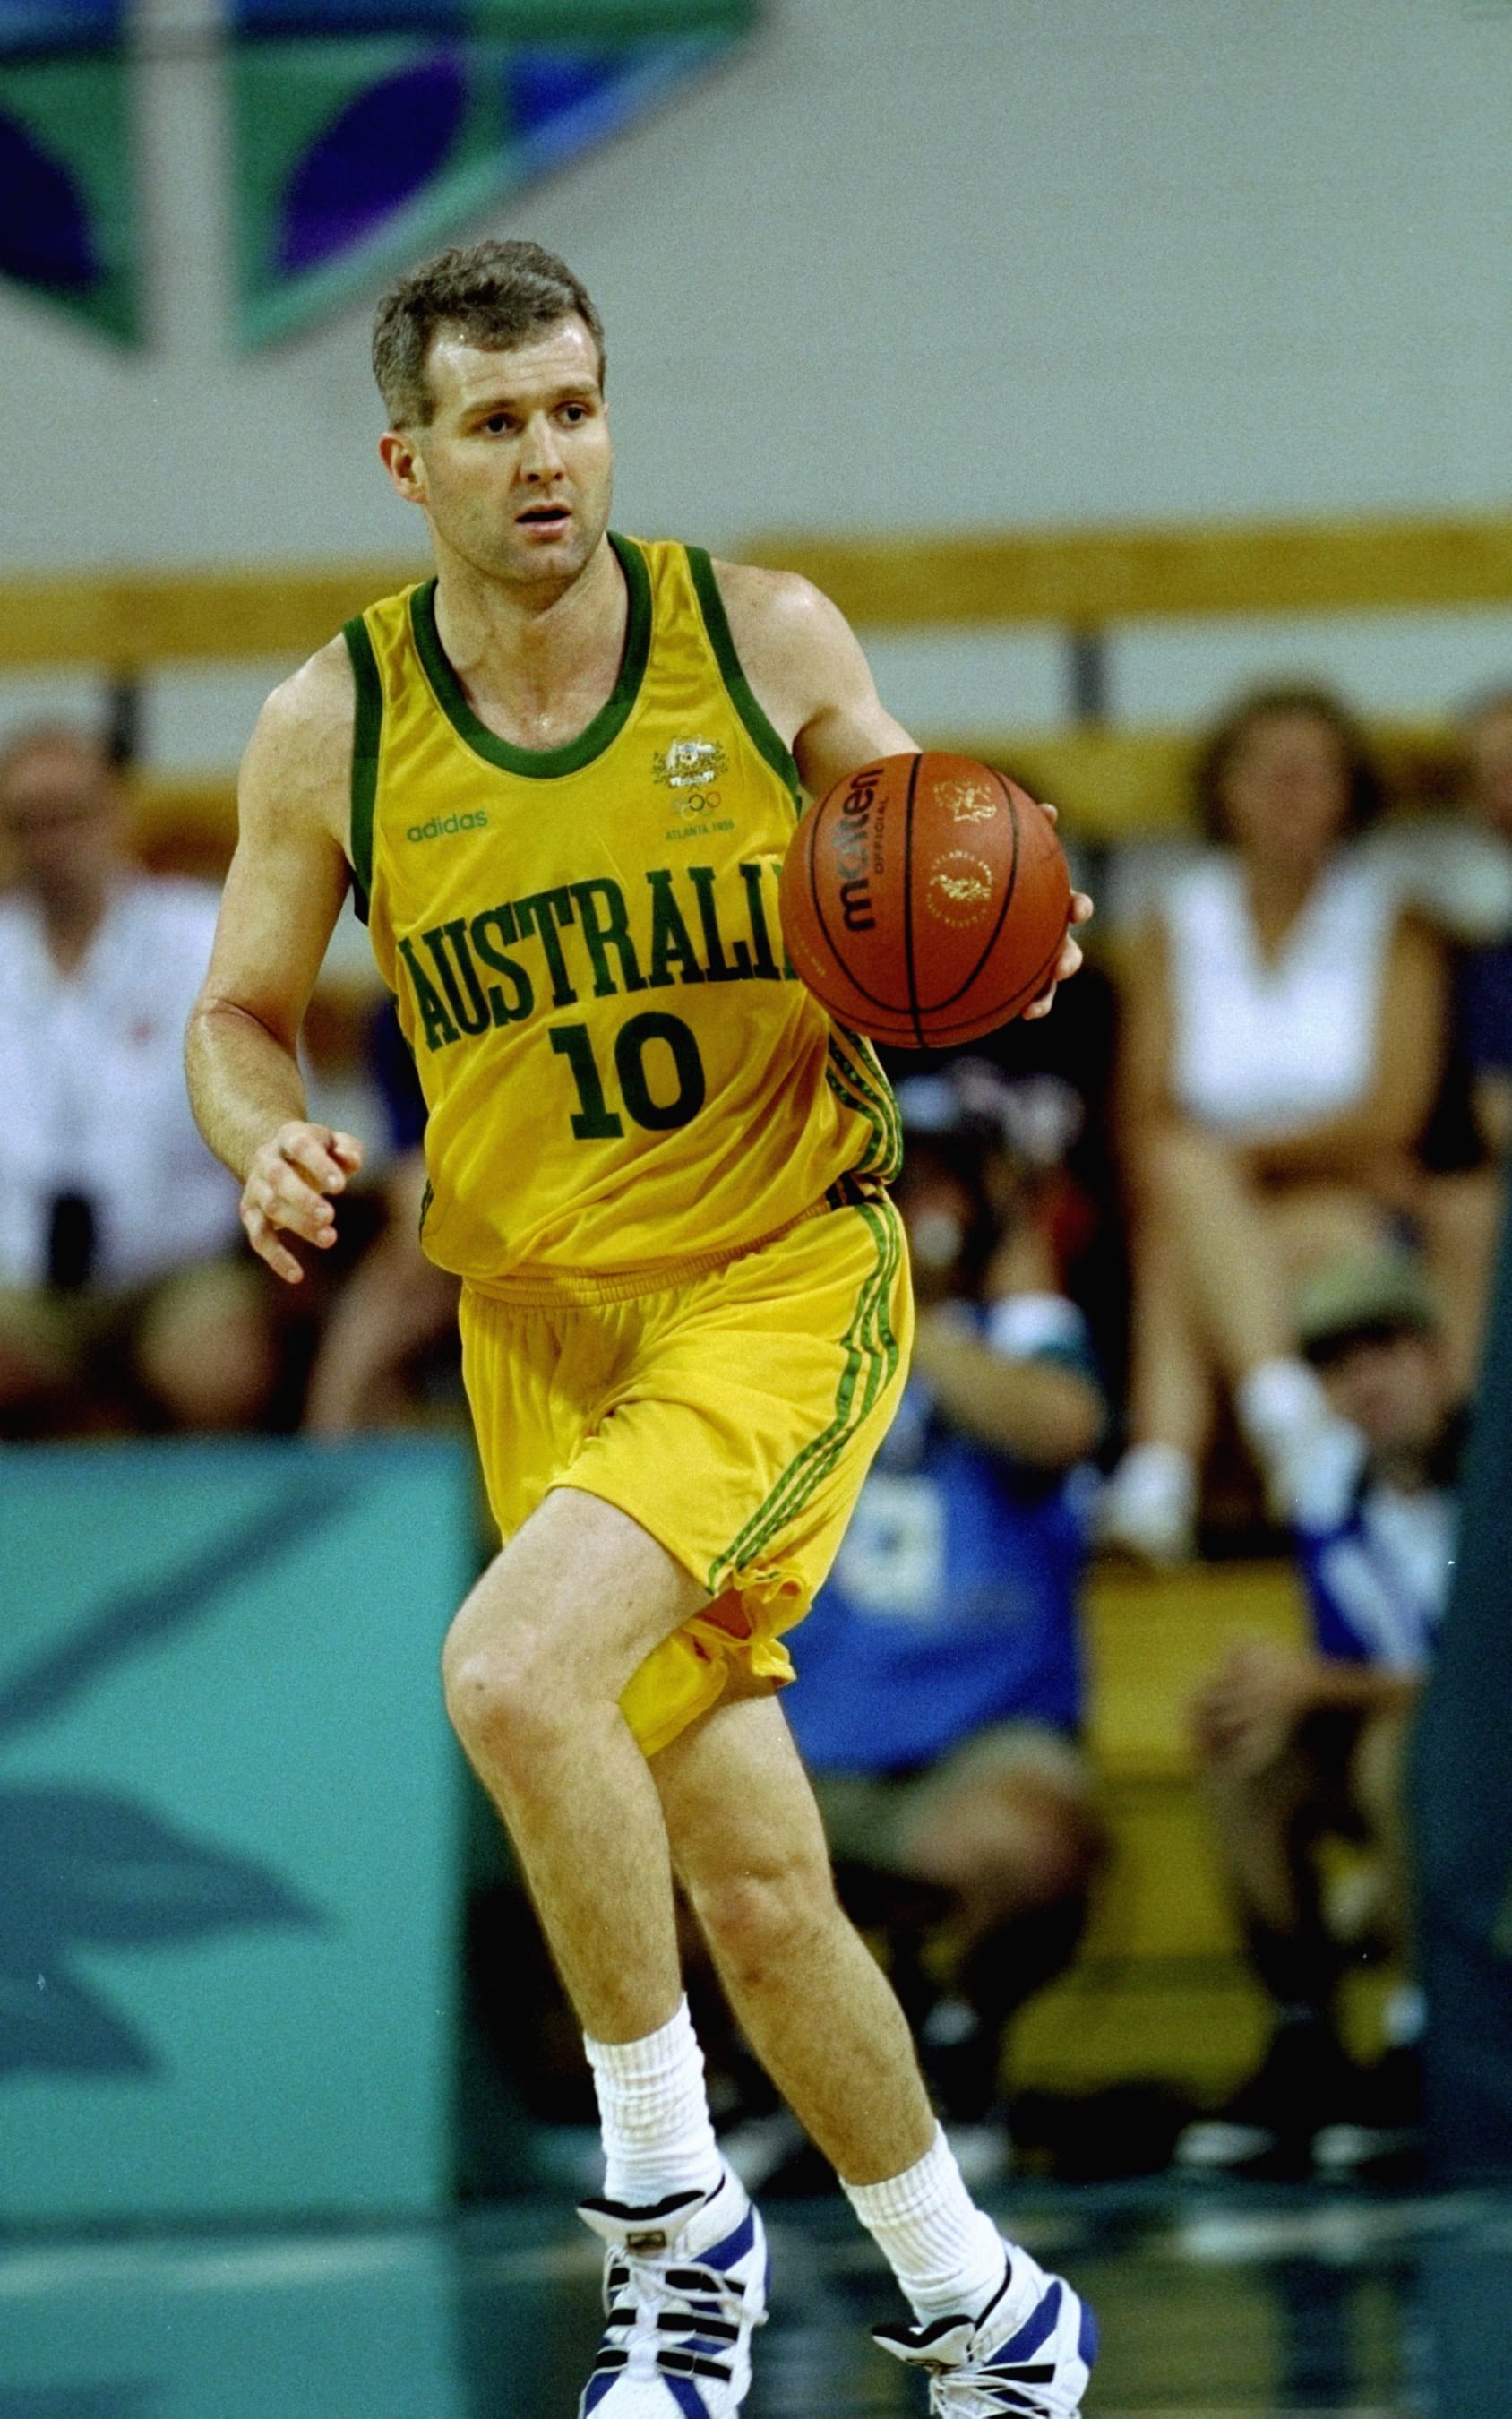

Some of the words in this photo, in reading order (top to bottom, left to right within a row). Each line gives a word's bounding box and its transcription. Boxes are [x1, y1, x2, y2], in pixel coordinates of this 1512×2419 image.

[407, 810, 488, 843] adidas
[831, 767, 885, 932] molten
[398, 863, 799, 1053] AUSTRALI
[548, 1011, 706, 1141] 10
